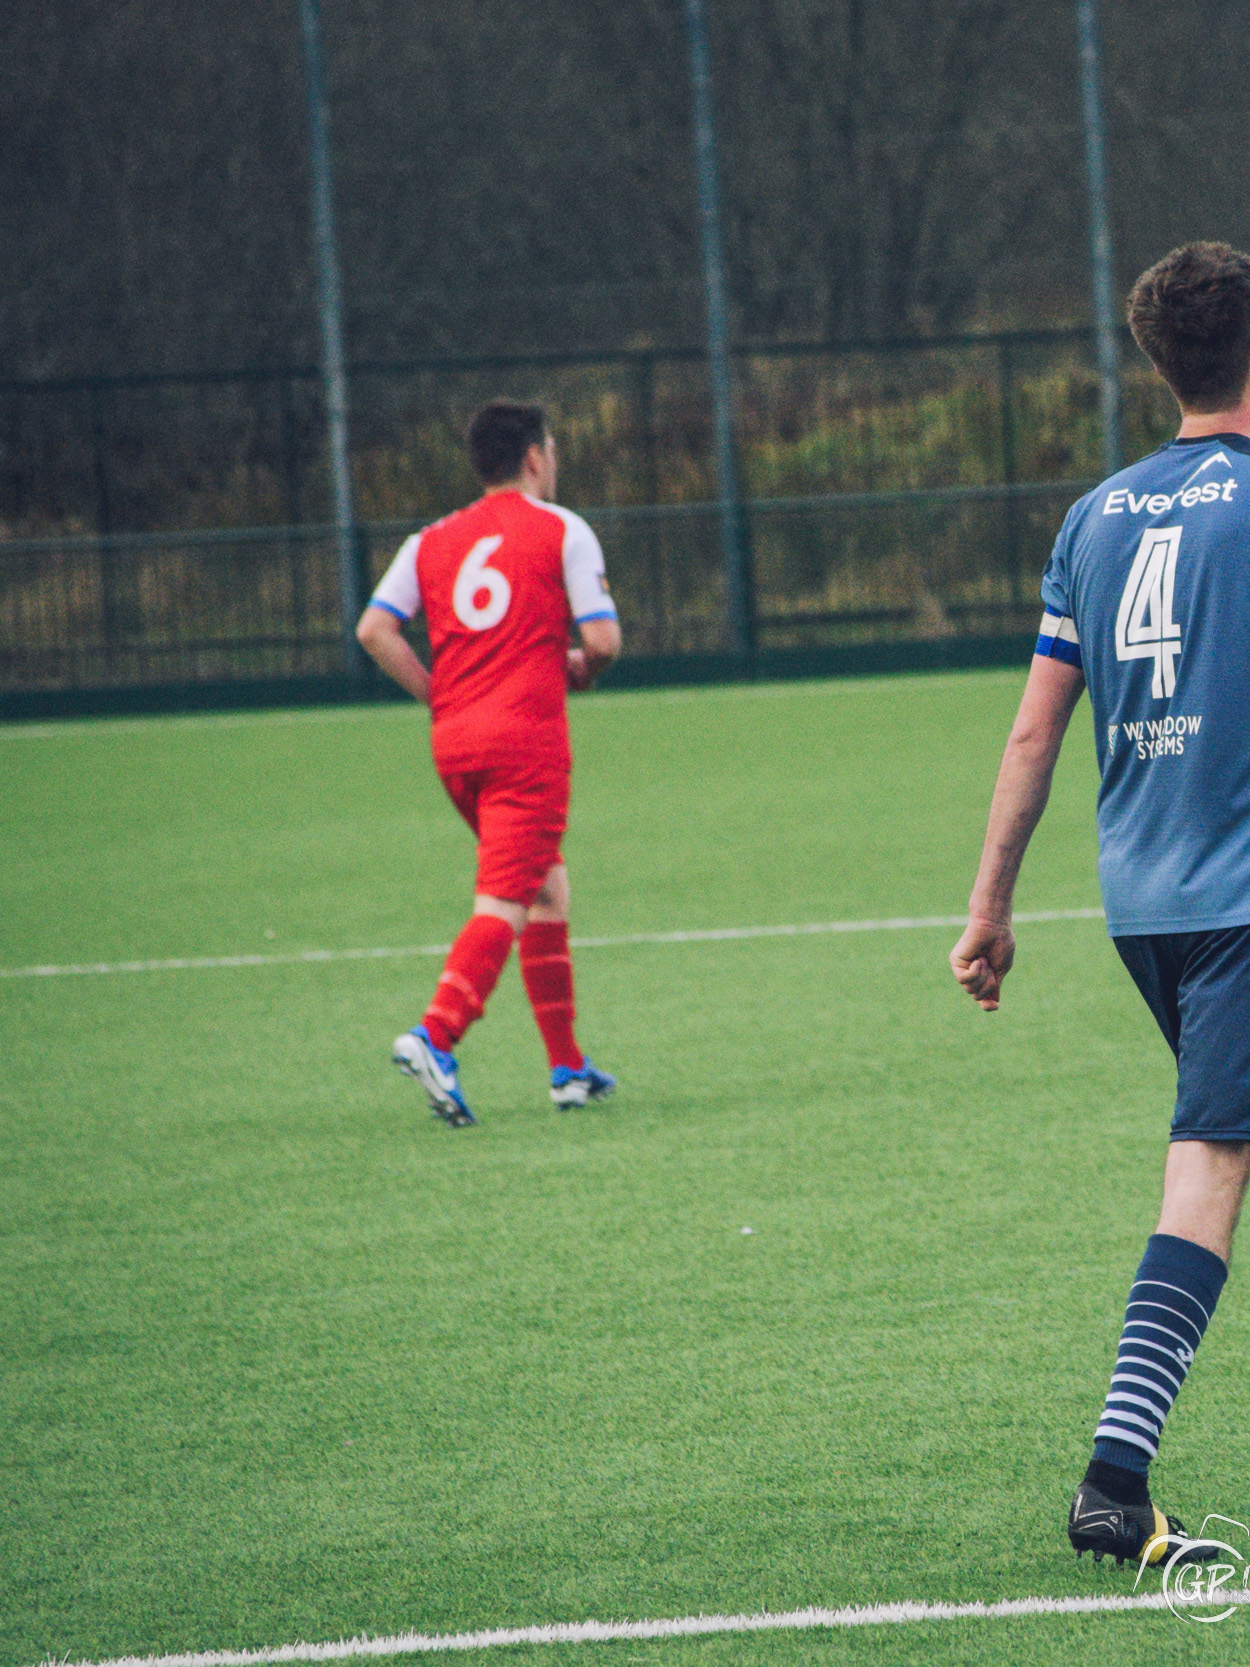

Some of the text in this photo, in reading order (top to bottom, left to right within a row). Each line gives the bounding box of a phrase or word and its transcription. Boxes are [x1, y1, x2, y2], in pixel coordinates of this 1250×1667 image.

[1103, 479, 1237, 515] Everest
[453, 534, 511, 631] 6
[1115, 526, 1182, 699] 4
[1146, 716, 1202, 739] WDOW
